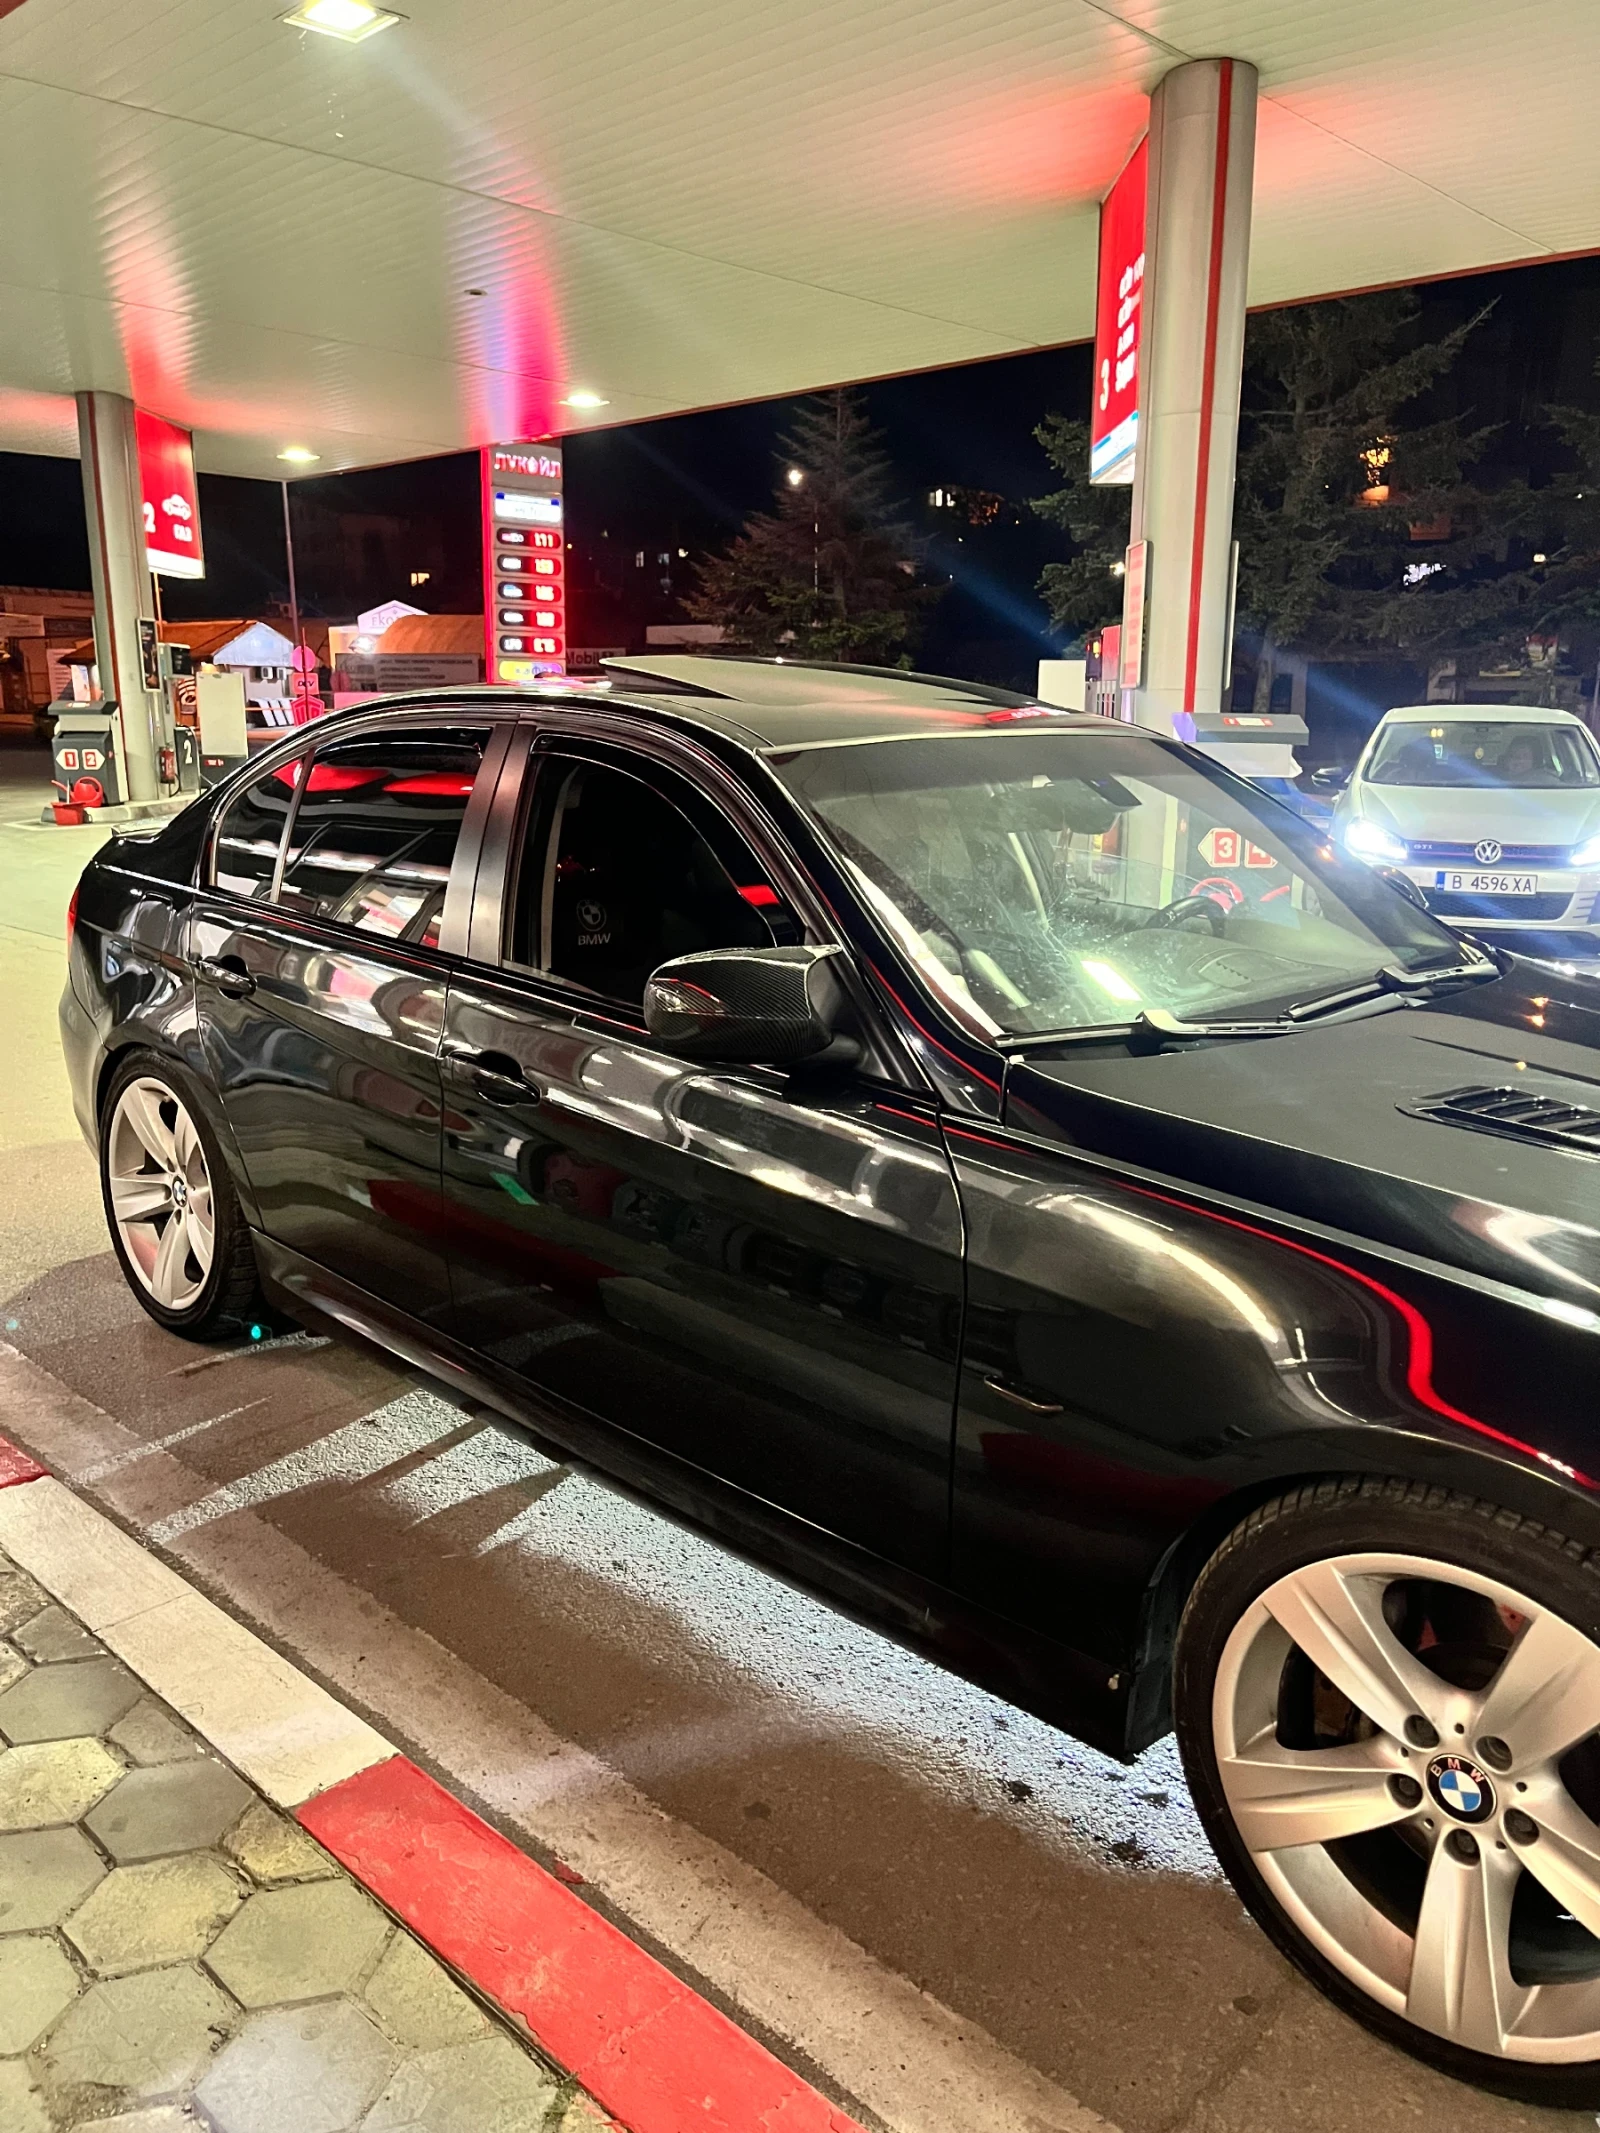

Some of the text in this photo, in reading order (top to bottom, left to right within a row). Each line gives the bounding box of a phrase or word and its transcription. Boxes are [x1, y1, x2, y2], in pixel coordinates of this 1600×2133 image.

[494, 452, 561, 479] ЛУКОЙЛ
[143, 501, 156, 533] 2
[67, 753, 96, 765] 1 2
[183, 739, 193, 764] 2
[1218, 837, 1233, 858] 3
[1452, 875, 1462, 889] B
[1471, 876, 1509, 891] 4596
[1512, 878, 1532, 892] XA
[577, 933, 611, 945] BMW
[1430, 1758, 1485, 1783] BMW
